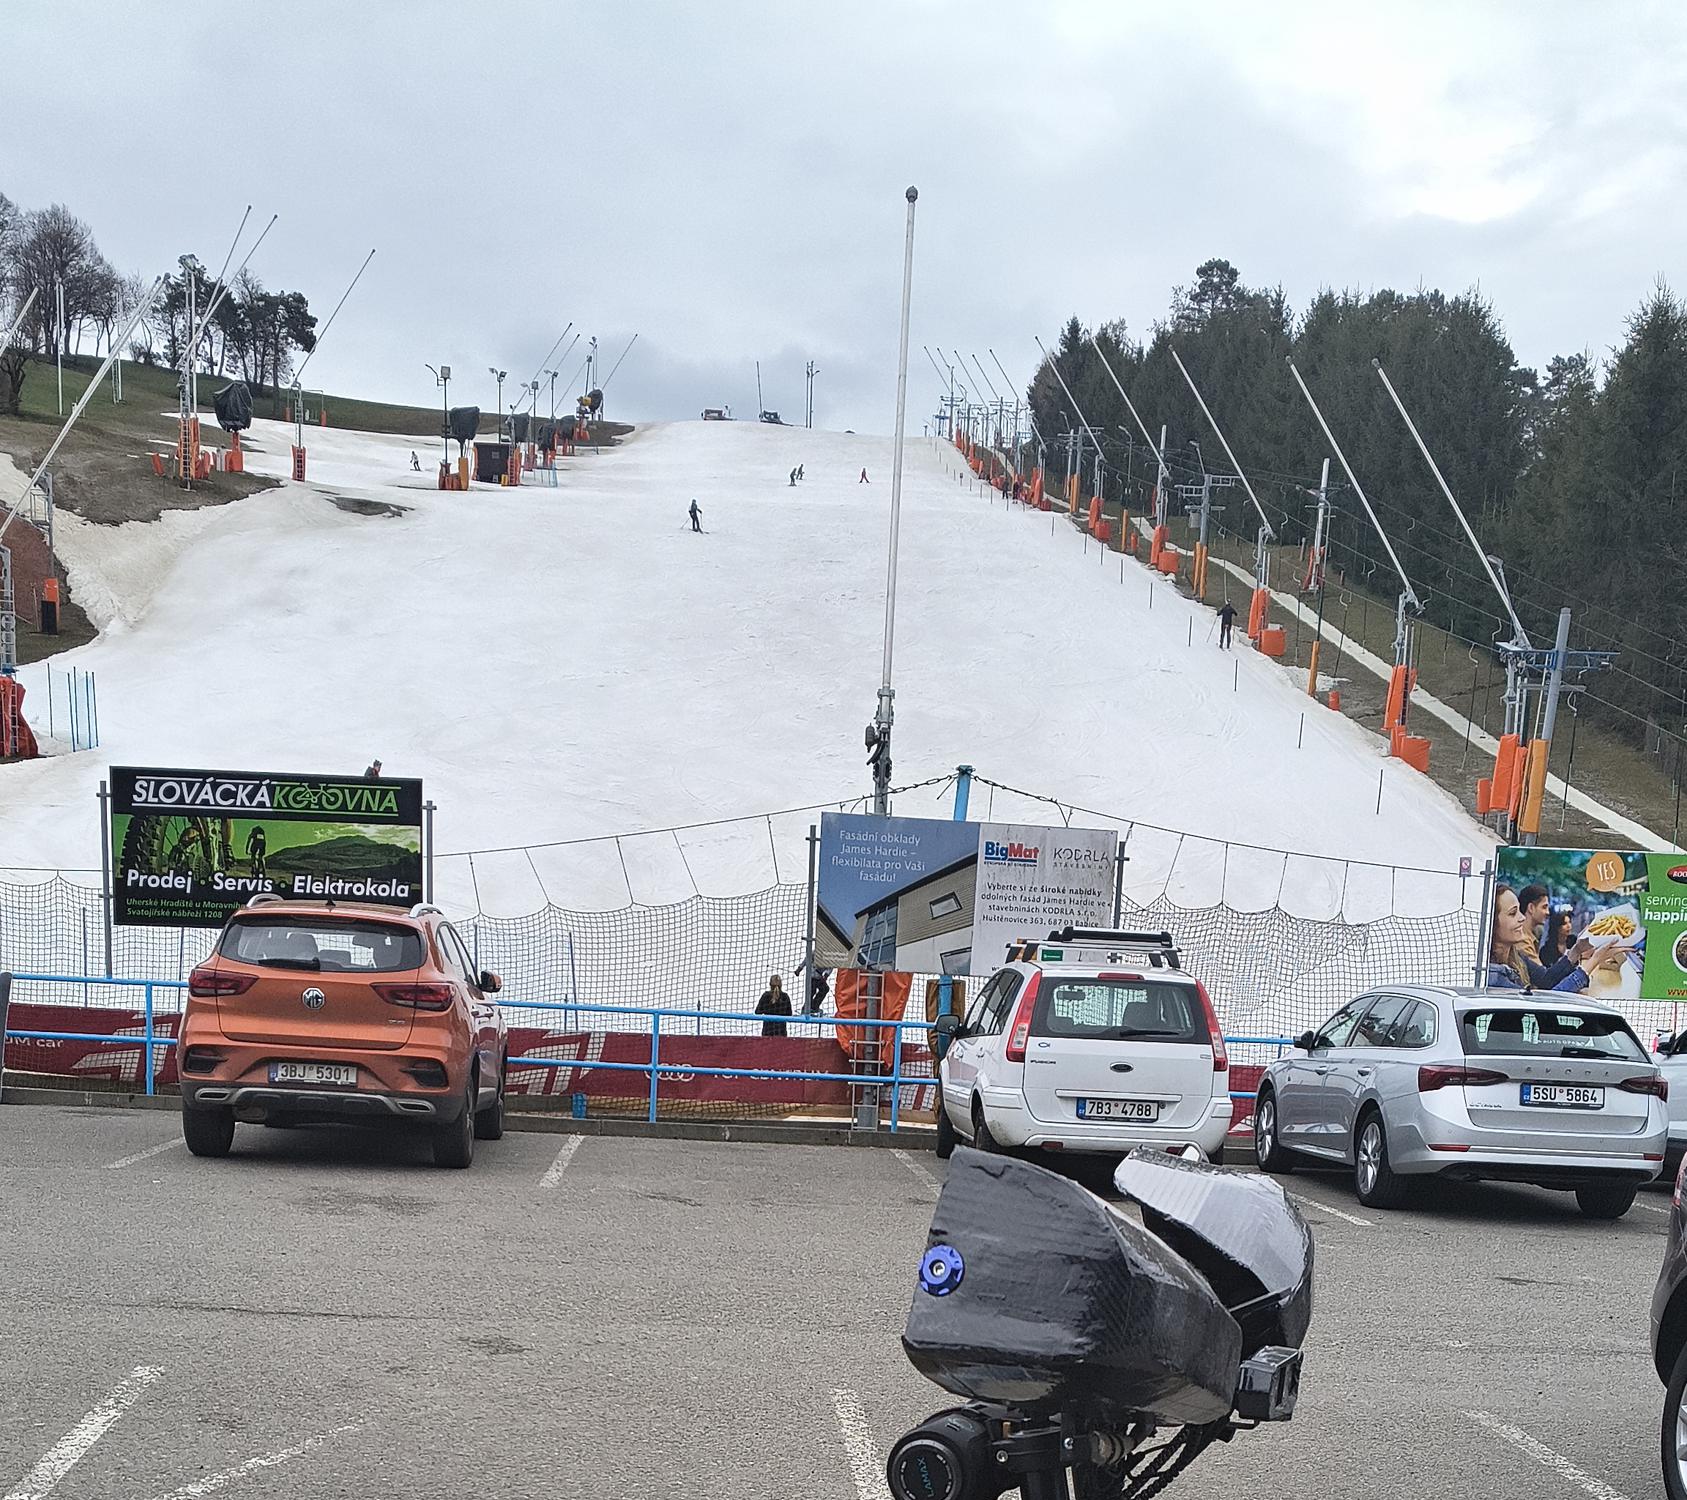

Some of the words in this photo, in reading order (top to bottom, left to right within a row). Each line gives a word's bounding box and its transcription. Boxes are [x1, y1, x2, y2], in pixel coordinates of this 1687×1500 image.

[132, 776, 271, 807] SLOVÁCKÁ
[880, 832, 921, 846] obklady
[840, 843, 872, 855] James
[874, 846, 908, 857] Hardie
[984, 841, 1039, 859] BigMat
[1053, 848, 1109, 861] KODRLA
[884, 862, 901, 871] pro
[904, 861, 925, 871] Vaši
[1597, 861, 1616, 881] YES
[126, 869, 192, 893] Prodej
[212, 873, 273, 892] Servis
[293, 876, 409, 898] Elektrokola
[859, 871, 896, 882] fasádu!
[986, 882, 1018, 892] Vyberte
[1040, 885, 1067, 894] široké
[1069, 887, 1102, 897] nabídky
[981, 893, 1018, 902] odolných
[1042, 897, 1067, 905] James
[1068, 898, 1095, 906] Hardie
[988, 904, 1040, 913] stavebninách
[1042, 906, 1075, 916] KODRLA
[36, 1038, 64, 1048] car
[280, 1064, 306, 1078] 3BJ
[316, 1066, 350, 1080] 5301
[1533, 1087, 1556, 1100] 5SU
[1566, 1088, 1597, 1102] 5864
[1089, 1101, 1111, 1114] 7B3
[1121, 1104, 1151, 1116] 4788
